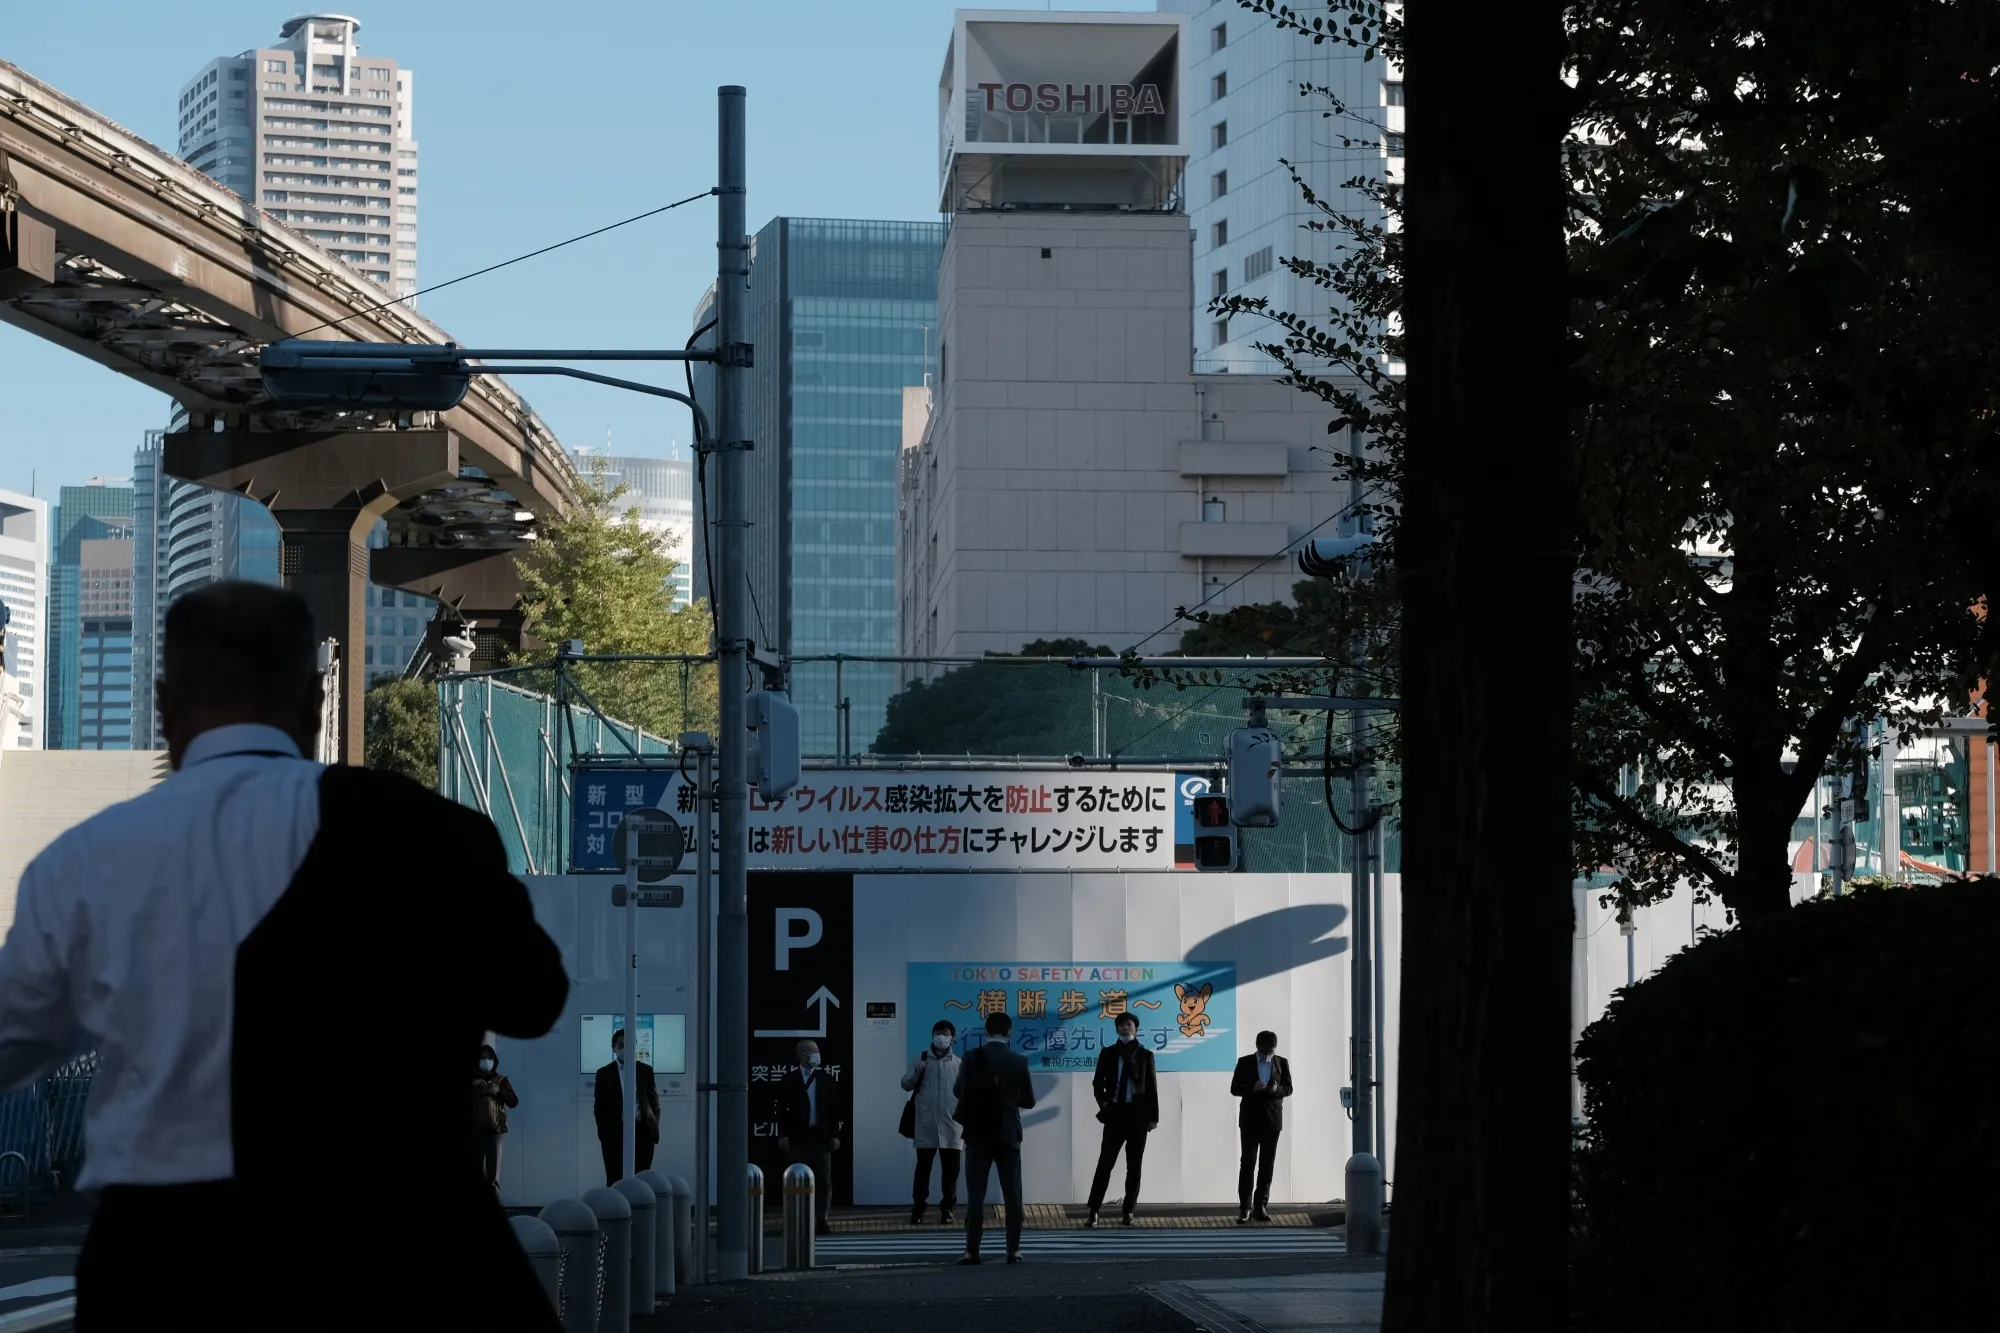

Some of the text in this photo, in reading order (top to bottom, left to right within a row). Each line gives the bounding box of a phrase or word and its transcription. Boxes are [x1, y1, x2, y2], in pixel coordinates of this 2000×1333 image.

[978, 83, 1165, 115] TOSHIBA
[588, 811, 623, 829] コロ
[586, 833, 606, 855] 対
[681, 825, 1164, 856] 私は新しい仕事の仕方にチャレンジします
[775, 907, 823, 971] P
[952, 967, 1154, 981] TOKYO SAFETY ACTION
